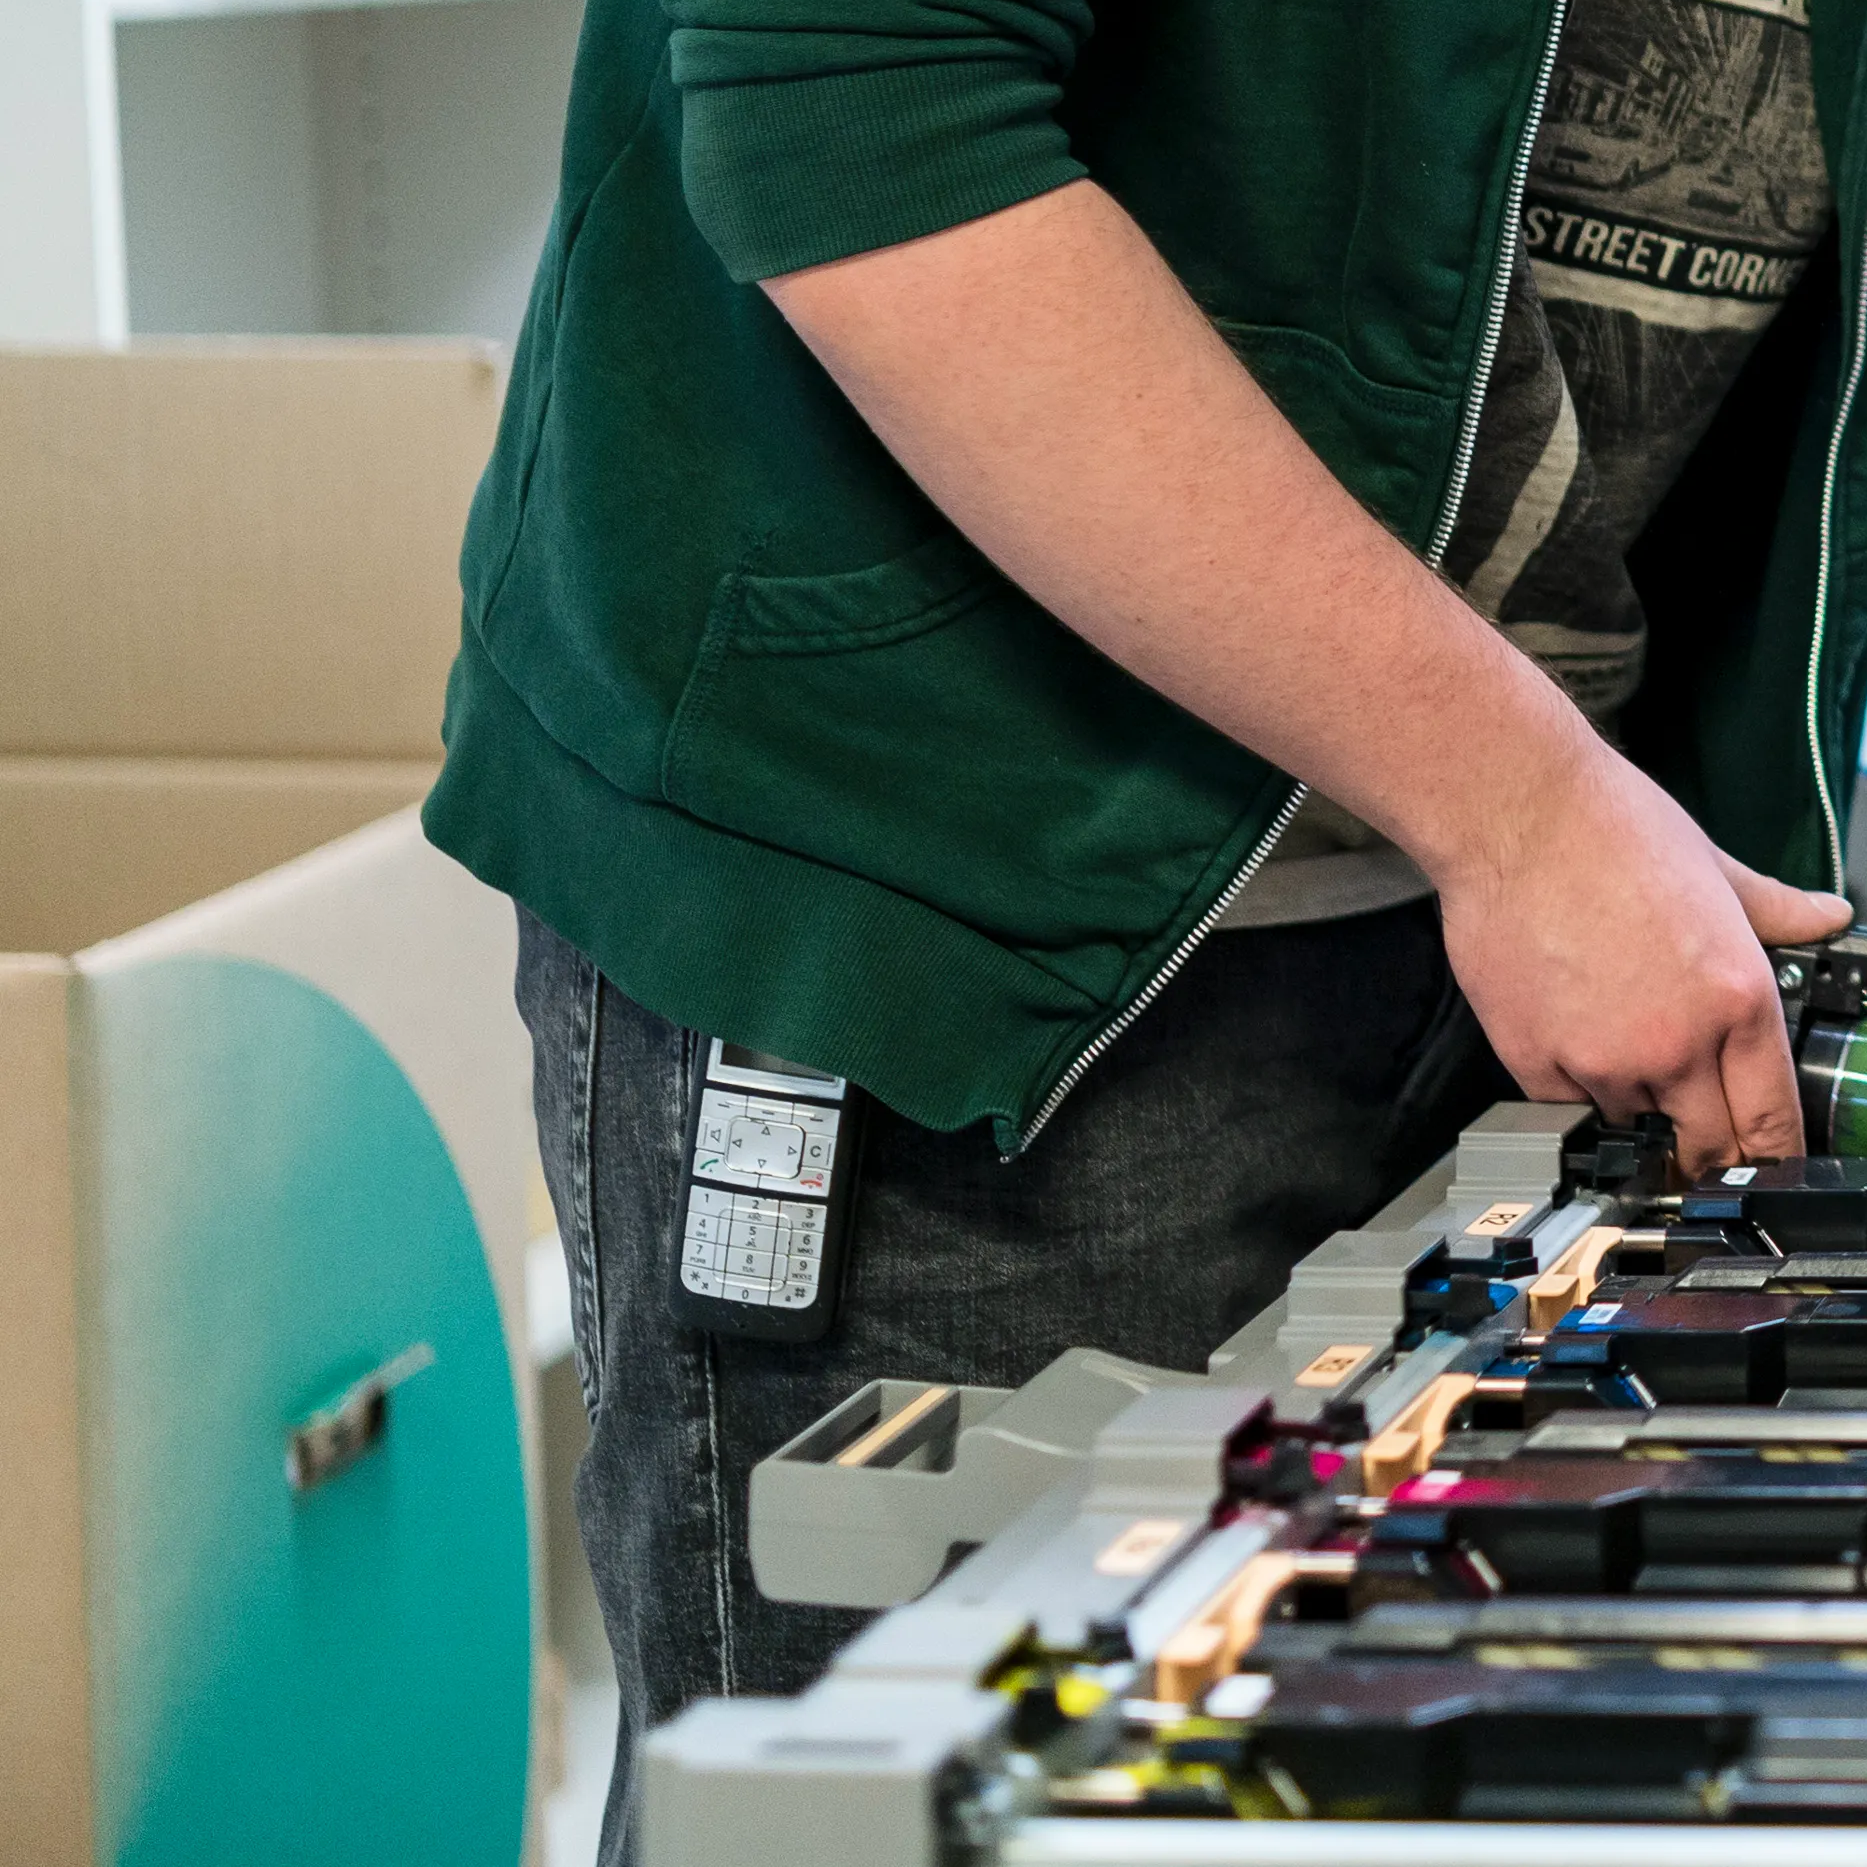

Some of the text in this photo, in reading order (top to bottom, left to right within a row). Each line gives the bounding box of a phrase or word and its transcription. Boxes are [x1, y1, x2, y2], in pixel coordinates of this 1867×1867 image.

[1523, 204, 1687, 282] STREET
[704, 1193, 710, 1204] 1
[751, 1199, 760, 1210] 2
[805, 1208, 814, 1219] 3
[748, 1226, 757, 1236] 5
[802, 1234, 811, 1246] 6
[696, 1243, 704, 1255] 7
[745, 1254, 754, 1265] 8
[799, 1260, 808, 1271] 9
[741, 1289, 749, 1300] 0
